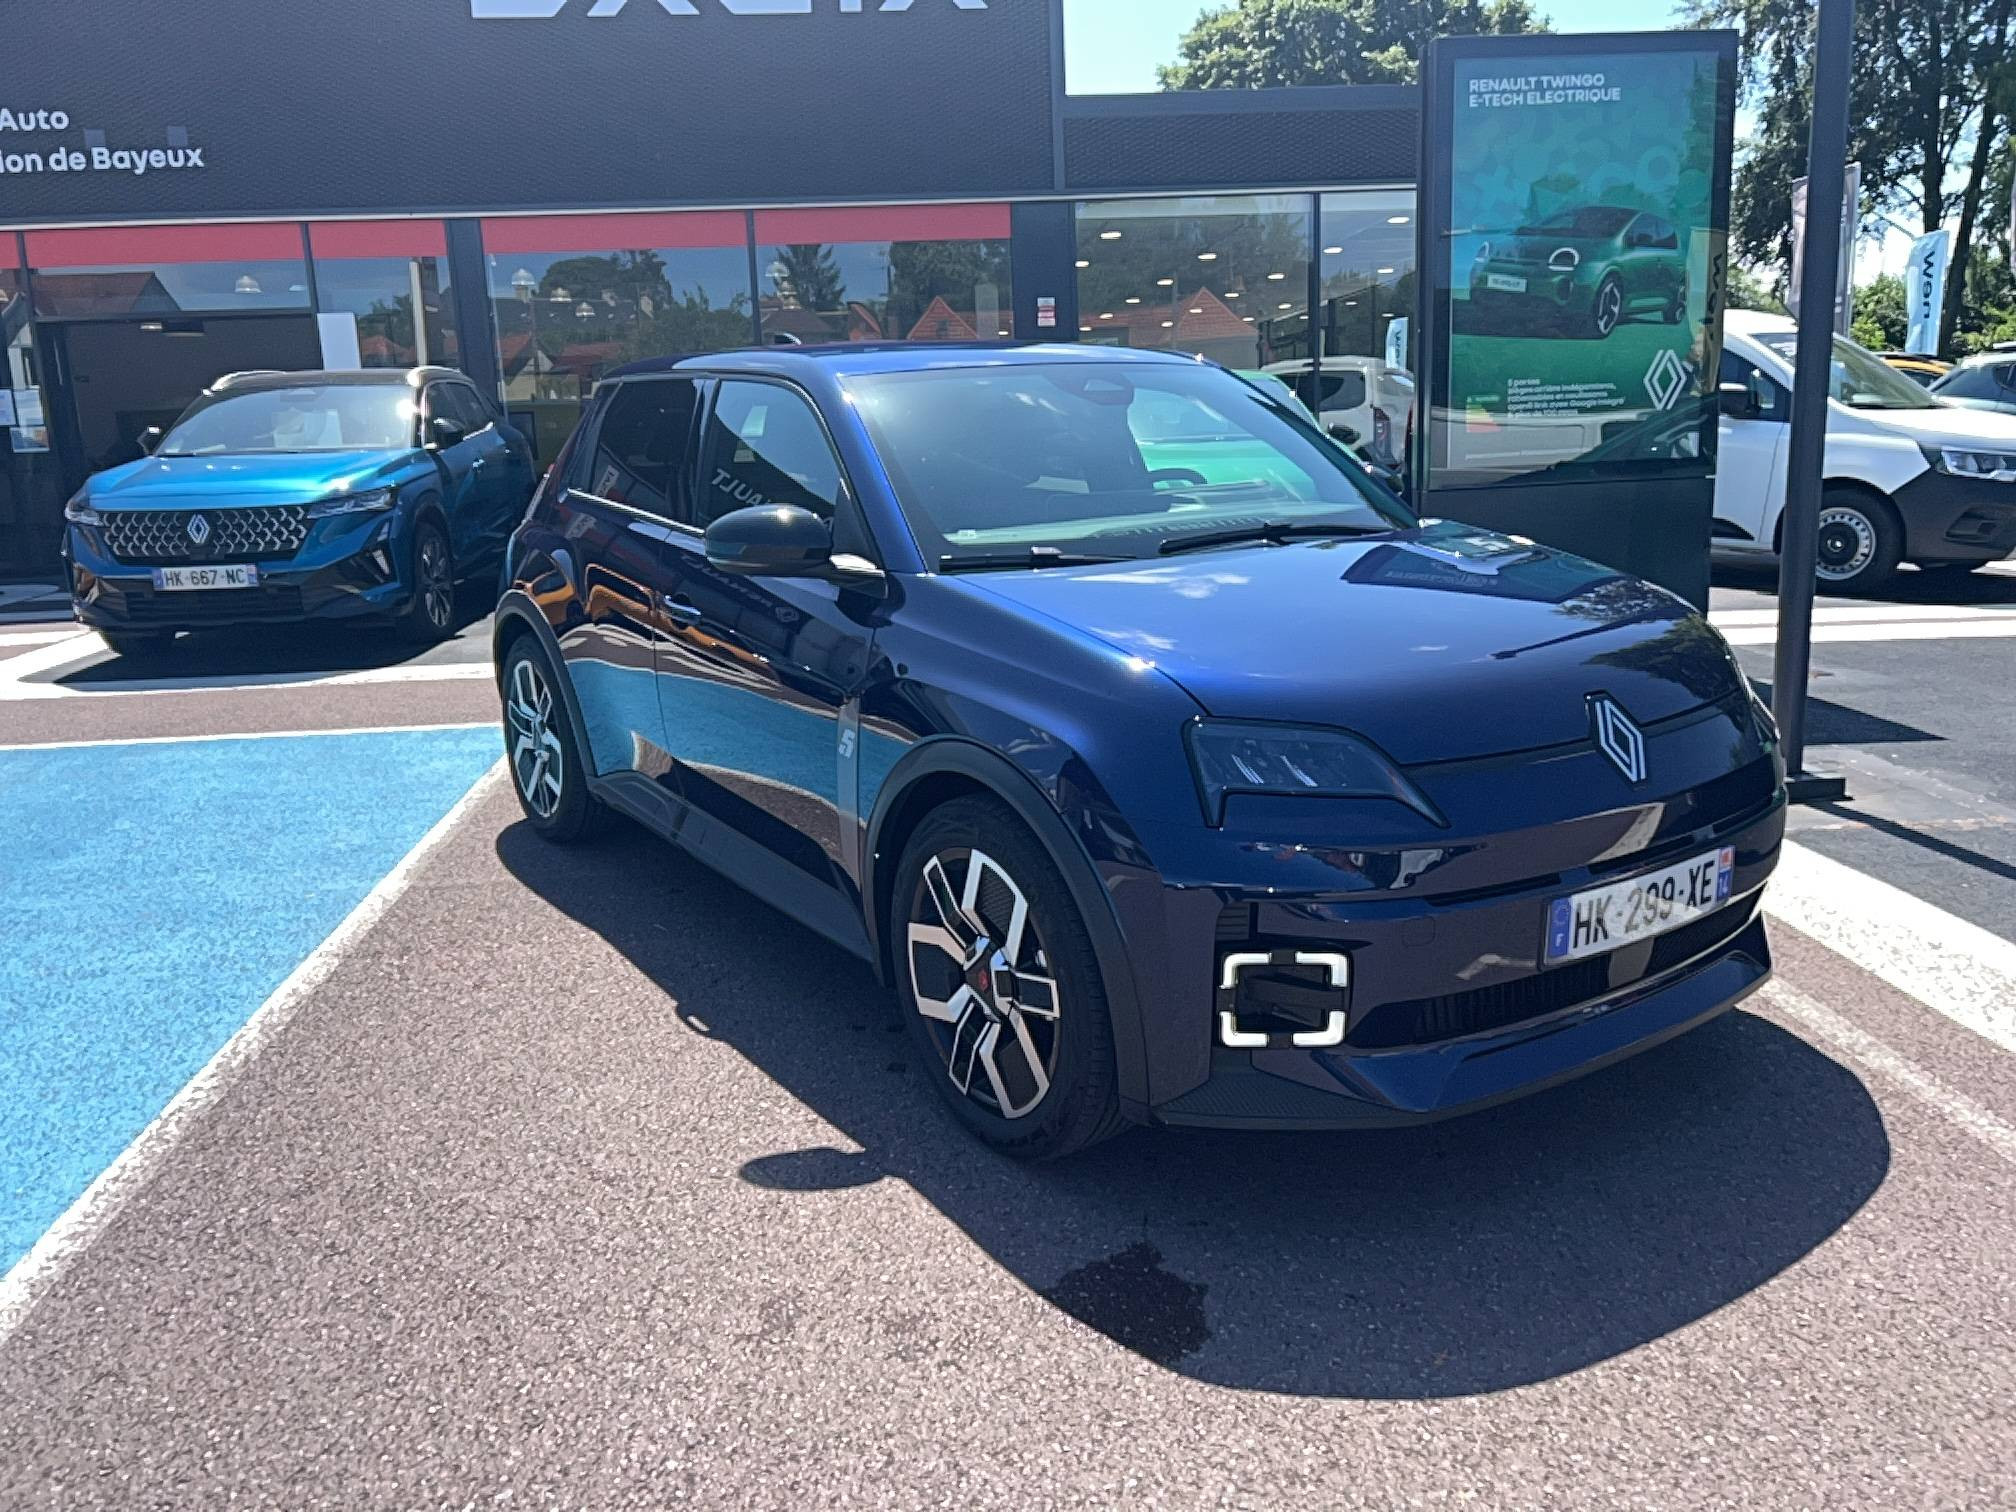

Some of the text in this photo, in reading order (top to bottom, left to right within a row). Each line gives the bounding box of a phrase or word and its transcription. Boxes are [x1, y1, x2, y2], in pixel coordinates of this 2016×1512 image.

[1469, 73, 1605, 92] RENAULT TWINGO
[1469, 87, 1622, 108] E-TECH ELECTRIQUE
[0, 108, 70, 132] Auto
[50, 147, 87, 172] de
[91, 146, 205, 176] Bayeux
[164, 567, 245, 587] HK-667-NC
[1573, 860, 1716, 949] HK-299-XE
